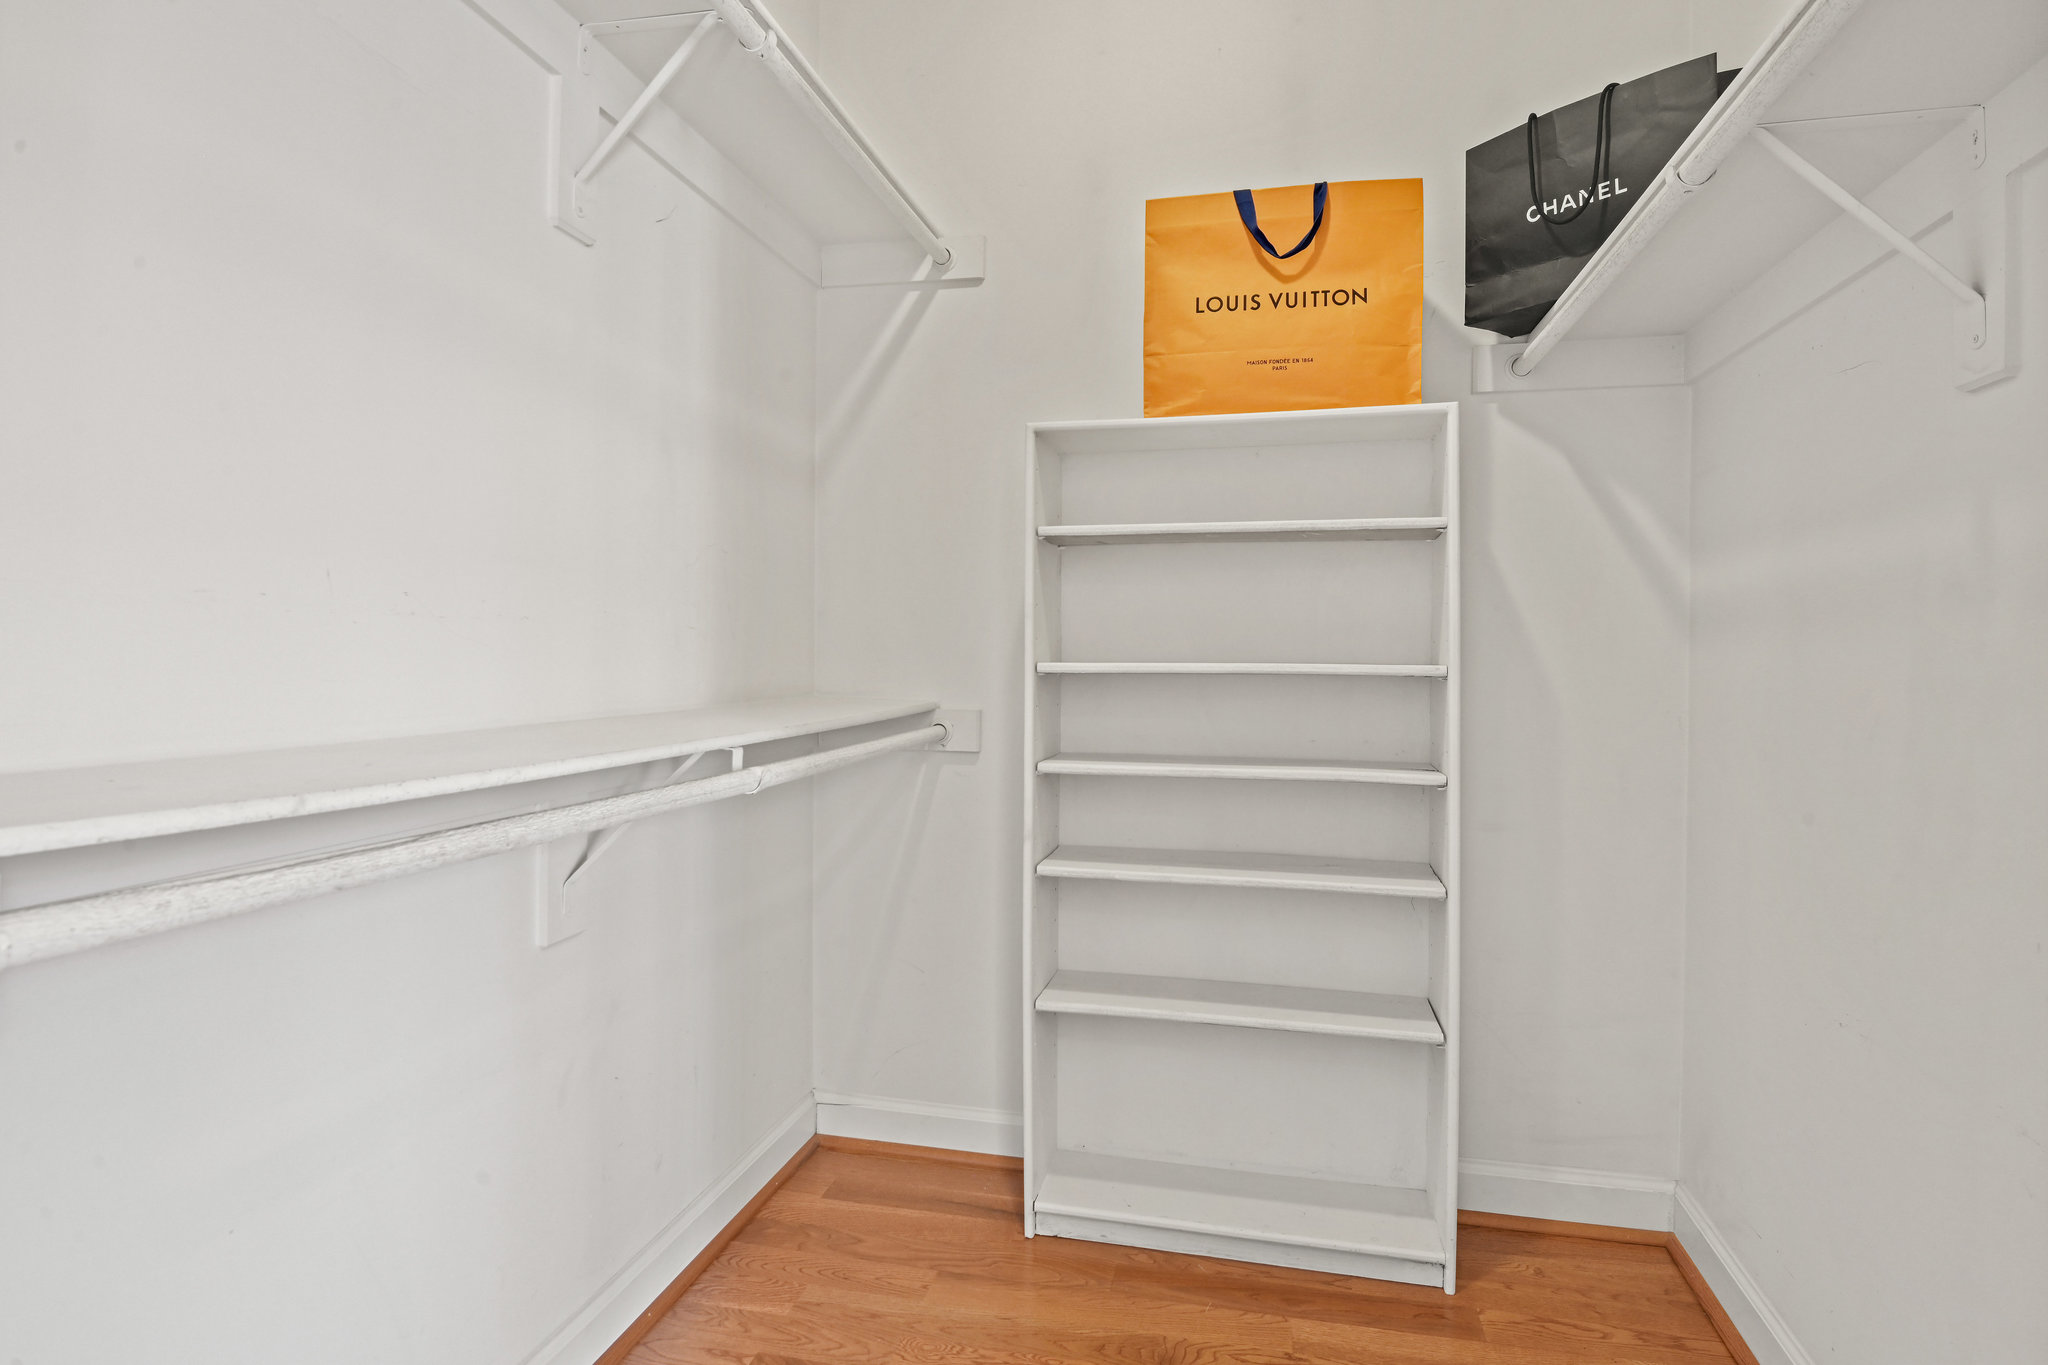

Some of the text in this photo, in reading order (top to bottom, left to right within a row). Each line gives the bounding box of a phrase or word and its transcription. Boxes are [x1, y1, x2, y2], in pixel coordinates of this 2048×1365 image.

[1526, 177, 1628, 223] CHANEL
[1195, 287, 1368, 314] LOUIS VUITTON
